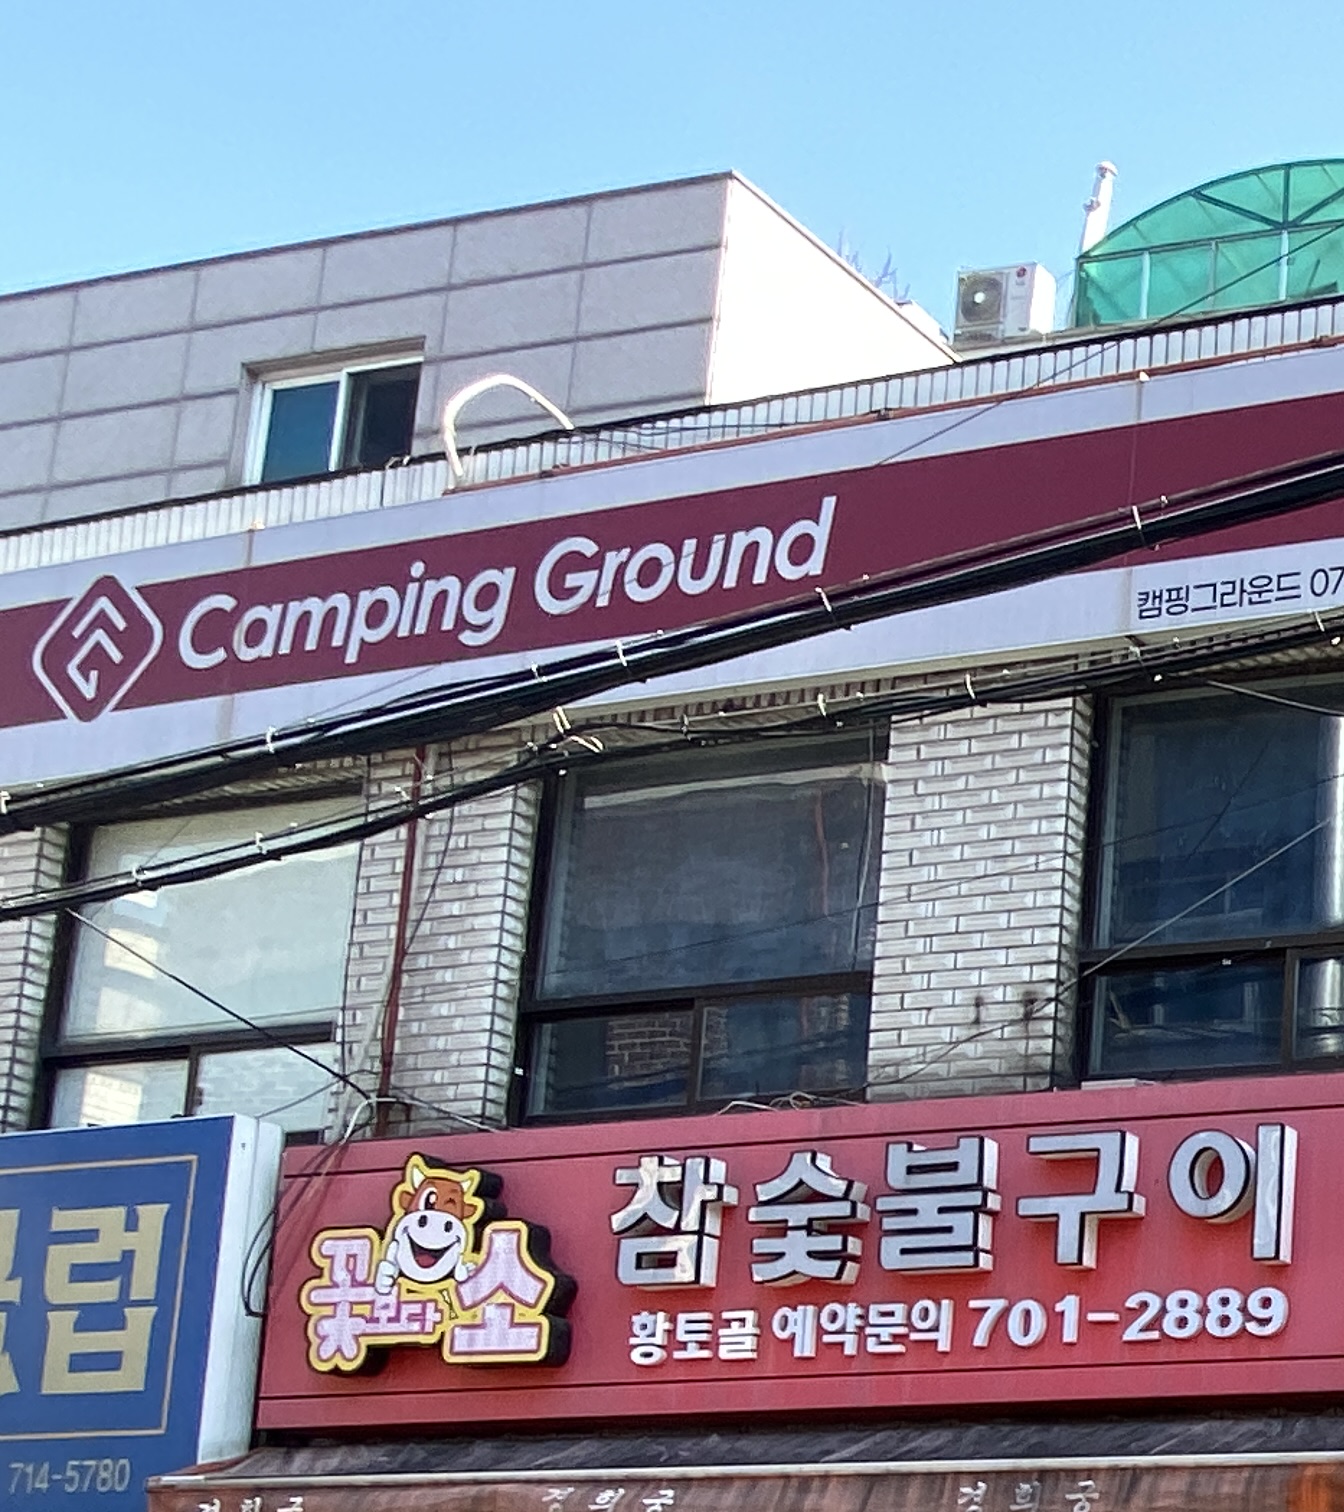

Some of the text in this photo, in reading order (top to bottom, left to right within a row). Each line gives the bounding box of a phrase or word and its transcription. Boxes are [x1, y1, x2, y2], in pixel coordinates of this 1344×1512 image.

[179, 496, 837, 670] Camping Ground
[1137, 572, 1303, 620] 캠핑그라운드
[609, 1122, 1296, 1289] 참숯불구이
[0, 1203, 168, 1396] 럽
[629, 1286, 1290, 1366] 황토골 예약문의 701-2889
[8, 1458, 131, 1494] 714-5780
